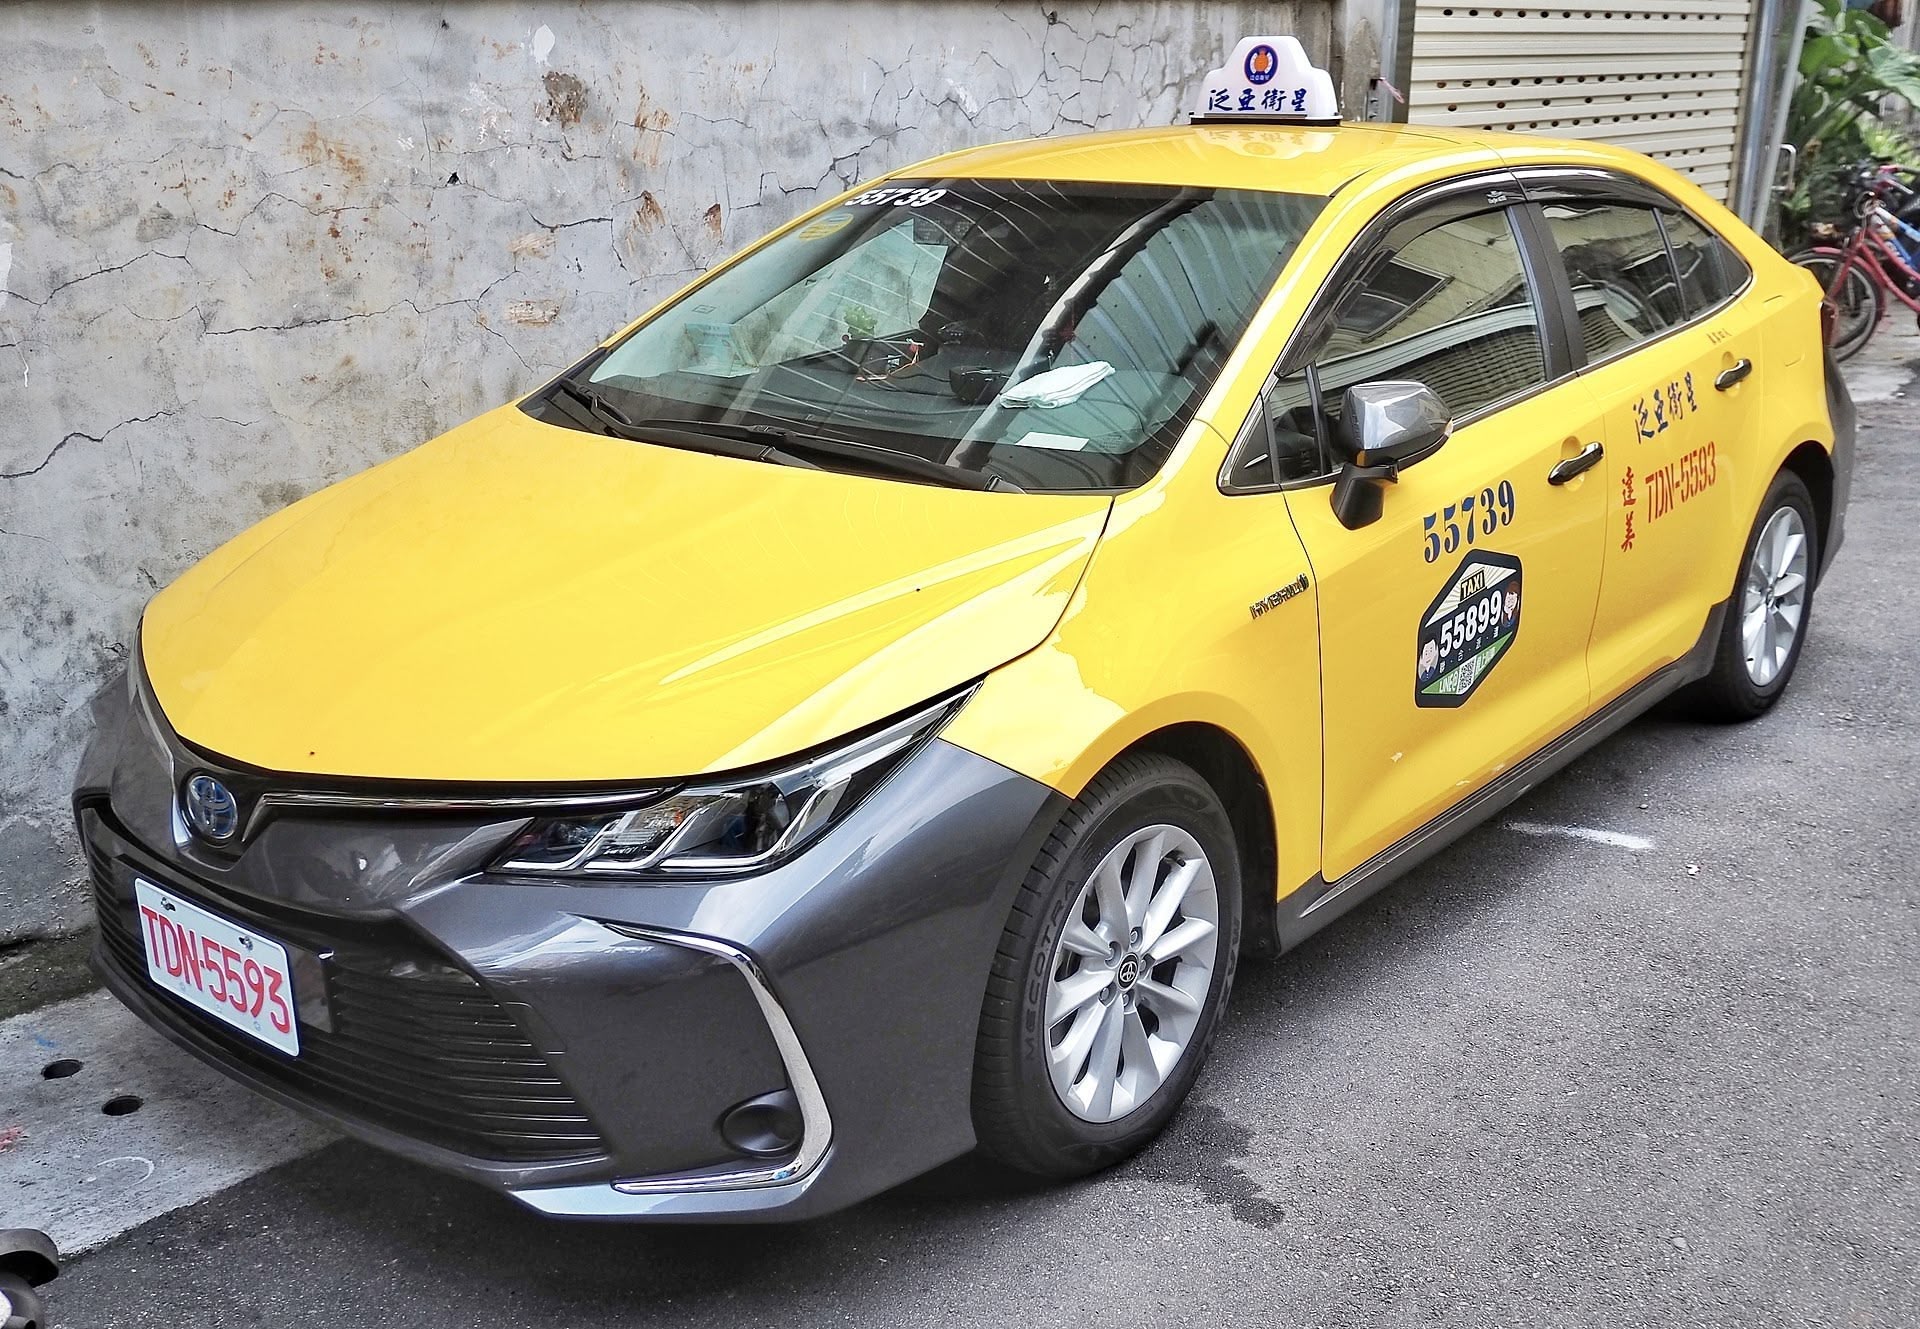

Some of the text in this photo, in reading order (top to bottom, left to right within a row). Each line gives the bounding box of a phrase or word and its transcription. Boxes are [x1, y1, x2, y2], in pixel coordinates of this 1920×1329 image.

[844, 188, 948, 208] 55739
[1423, 479, 1516, 563] 55739
[1644, 441, 1717, 524] TDN-5593
[1439, 590, 1503, 658] 55899
[1460, 570, 1485, 598] TAXI
[141, 905, 291, 1034] TDN-5593
[1022, 879, 1079, 1061] MECOTRA
